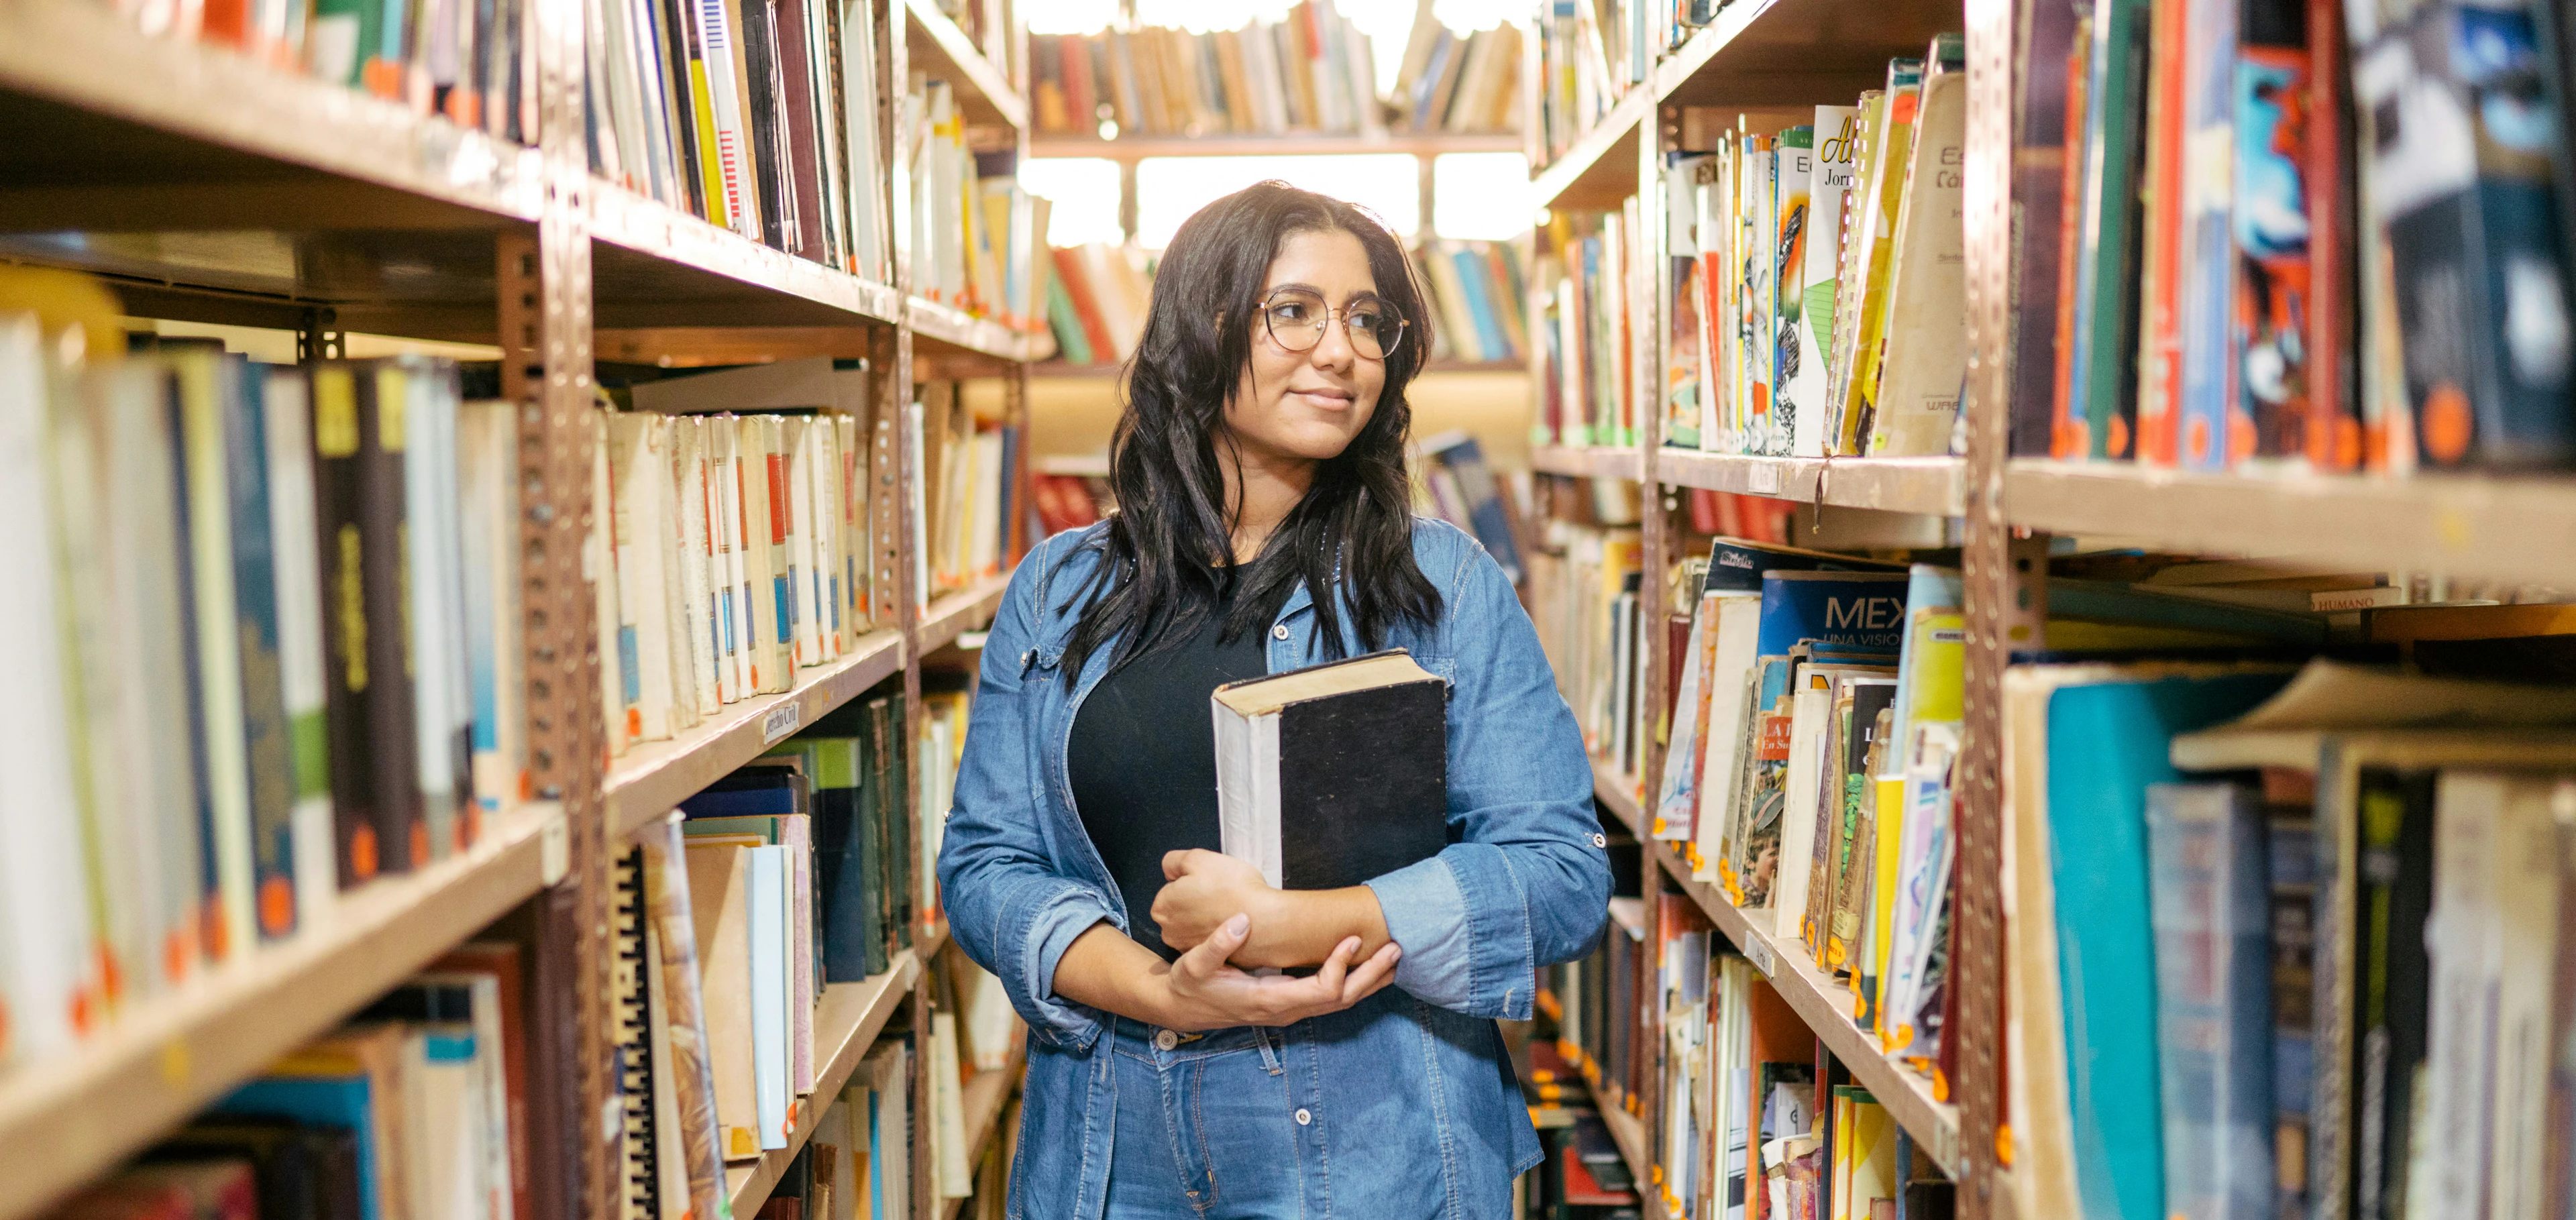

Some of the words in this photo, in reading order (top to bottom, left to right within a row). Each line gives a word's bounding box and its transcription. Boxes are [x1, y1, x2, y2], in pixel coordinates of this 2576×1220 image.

[2319, 598, 2374, 610] HUMANO
[1824, 634, 1856, 645] UNA
[784, 704, 796, 724] Civil
[1756, 946, 1766, 968] Arte
